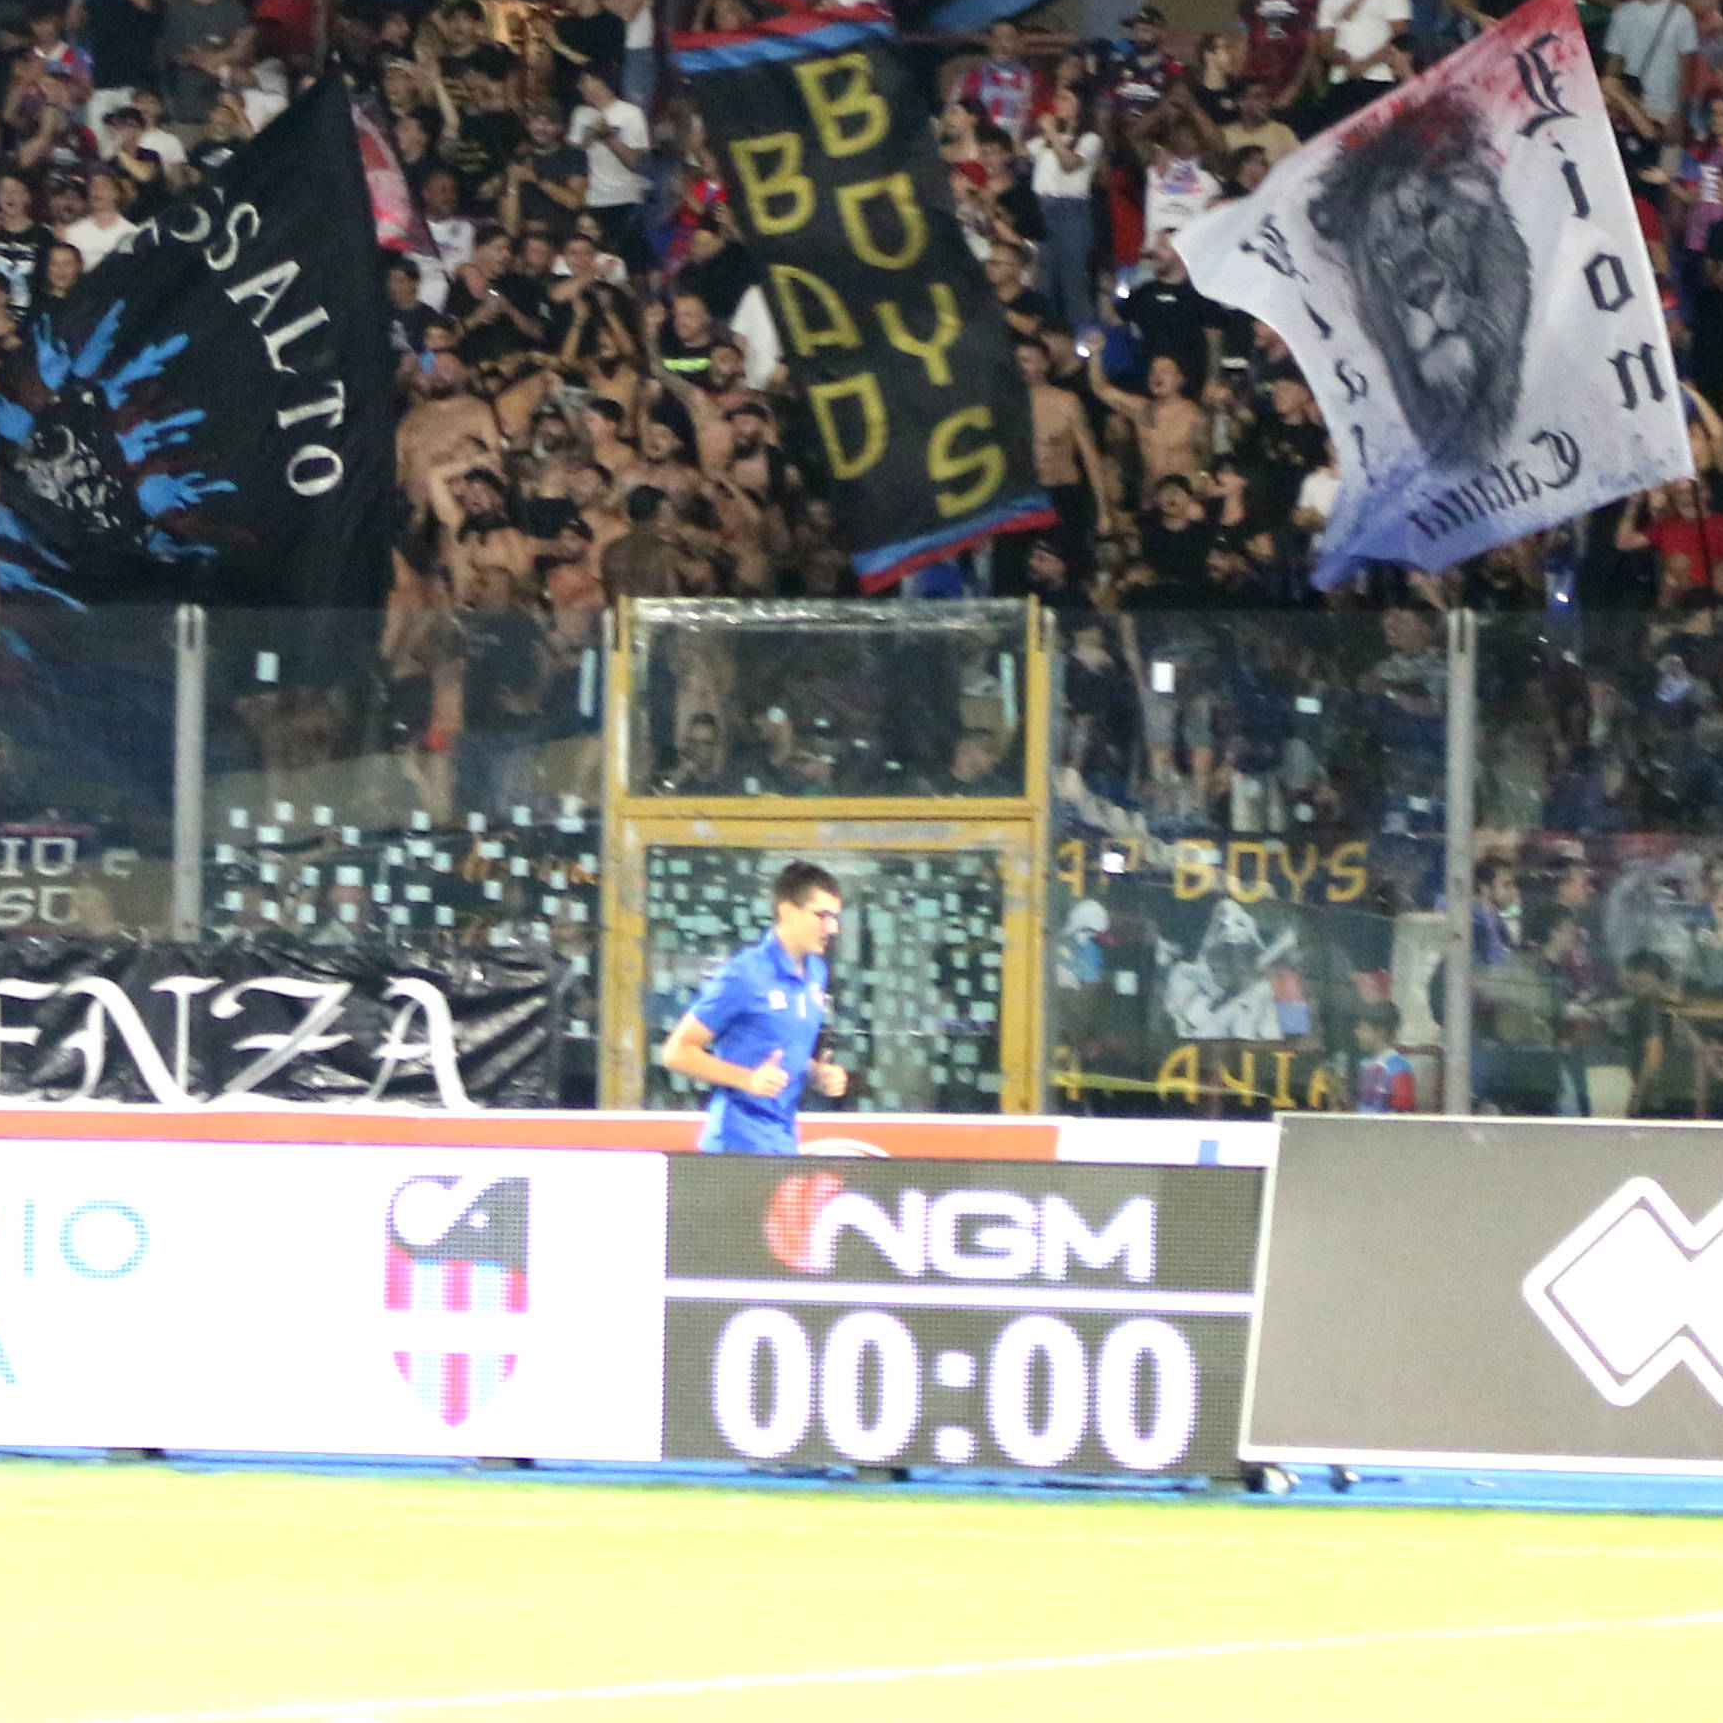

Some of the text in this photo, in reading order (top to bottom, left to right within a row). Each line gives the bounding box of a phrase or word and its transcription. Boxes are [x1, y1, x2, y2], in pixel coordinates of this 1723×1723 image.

[729, 132, 887, 481] BAD
[793, 52, 1007, 519] BOYS
[804, 1188, 1158, 1282] NGM
[713, 1306, 1199, 1470] 00:00
